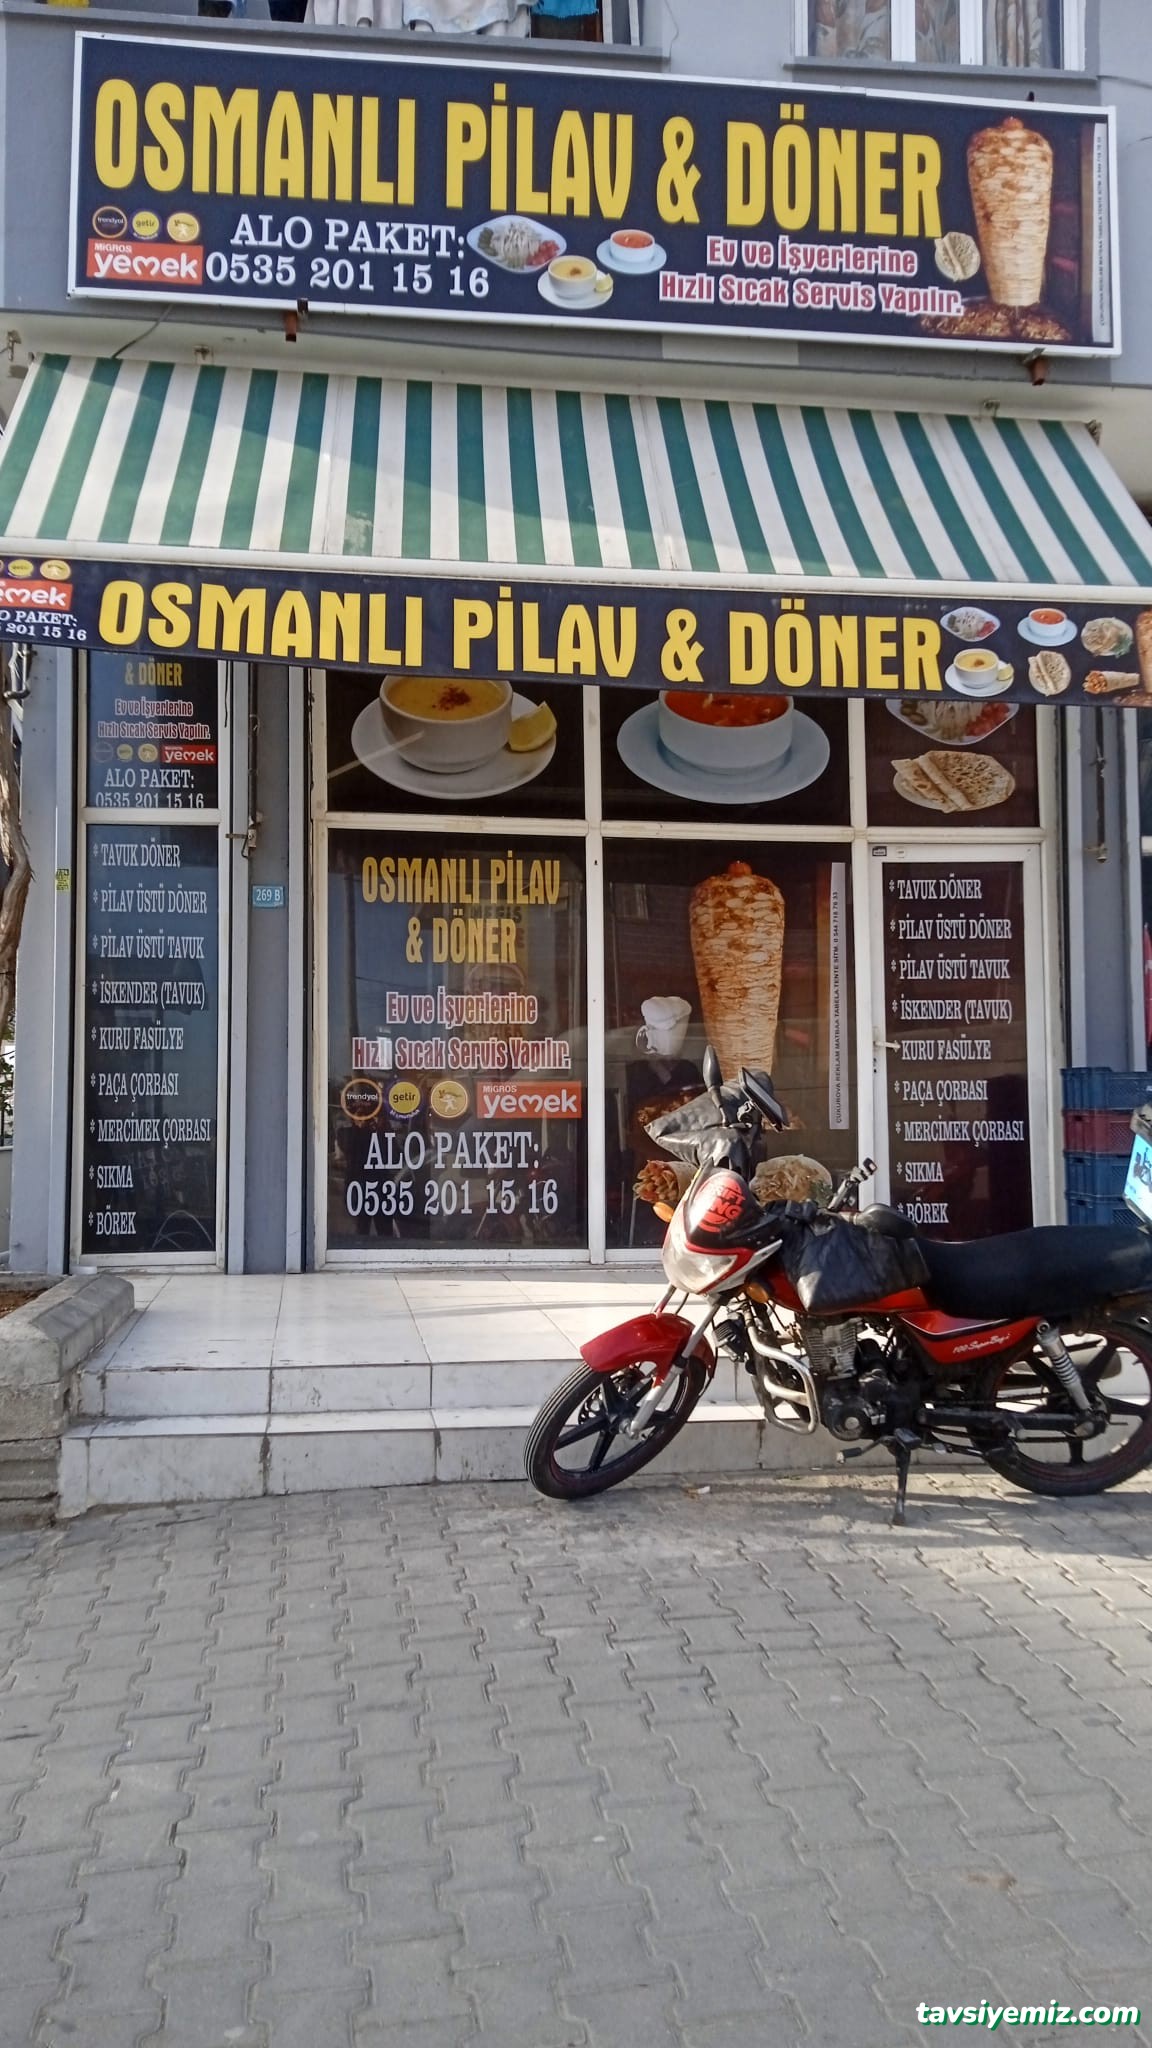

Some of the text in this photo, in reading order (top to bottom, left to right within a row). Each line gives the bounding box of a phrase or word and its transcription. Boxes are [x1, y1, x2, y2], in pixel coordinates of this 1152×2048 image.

[94, 78, 416, 207] OSMANLI
[446, 82, 634, 219] PİLAV
[656, 115, 702, 224] &
[726, 103, 942, 238] DÖNER
[230, 213, 465, 260] ALO PAKET:
[93, 252, 198, 279] yemek
[706, 235, 918, 277] Ev ve İşyerlerine
[205, 251, 490, 298] 0535 201 15 16
[659, 271, 965, 317] Hızlı Sıcak Servis Yapılır.
[6, 622, 87, 641] 201 15 16
[15, 610, 77, 627] PAKET:
[98, 579, 943, 693] OSMANLI PİLAV & DÖNER
[125, 657, 182, 686] & DÖNER
[164, 749, 214, 763] yemek
[104, 768, 194, 788] ALO PAKET:
[95, 791, 204, 808] 0535 201 15 16
[101, 837, 181, 867] TAVUK DÖNER
[362, 849, 561, 905] OSMANLI PİLAV
[897, 873, 982, 900] TAVUK DÖNER
[100, 882, 208, 914] PİLAV ÜSTÜ DÖNER
[256, 888, 281, 902] 269 B
[405, 908, 517, 964] & DÖNER
[899, 913, 1012, 939] PİLAV ÜSTÜ DÖNER
[100, 928, 205, 959] PİLAV ÜSTÜ TAVUK
[899, 953, 1010, 979] PİLAV ÜSTÜ TAVUK
[100, 974, 205, 1010] İSKENDER (TAVUK)
[386, 985, 538, 1030] Ev ve İşyerlerine
[900, 994, 1012, 1024] İSKENDER (TAVUK)
[98, 1020, 184, 1050] KURU FASÜLYE
[902, 1034, 991, 1060] KURU FASÜLYE
[395, 1036, 446, 1070] Sıcak
[449, 1036, 508, 1070] Servis
[509, 1037, 572, 1072] Yapılır.
[98, 1072, 179, 1103] PAÇA ÇORBASI
[346, 1093, 378, 1102] trendyol
[393, 1093, 416, 1104] getir
[902, 1080, 988, 1106] PAÇA ÇORBASI
[483, 1089, 578, 1118] yemek
[97, 1112, 211, 1149] MERCİMEK ÇORBASI
[904, 1115, 1024, 1147] MERCİMEK ÇORBASI
[364, 1131, 539, 1170] ALO PAKET:
[96, 1165, 134, 1189] SIKMA
[905, 1162, 944, 1182] SIKMA
[346, 1178, 558, 1216] 0535 201 15 16
[907, 1197, 949, 1223] BÖREK
[96, 1205, 136, 1236] BÖREK
